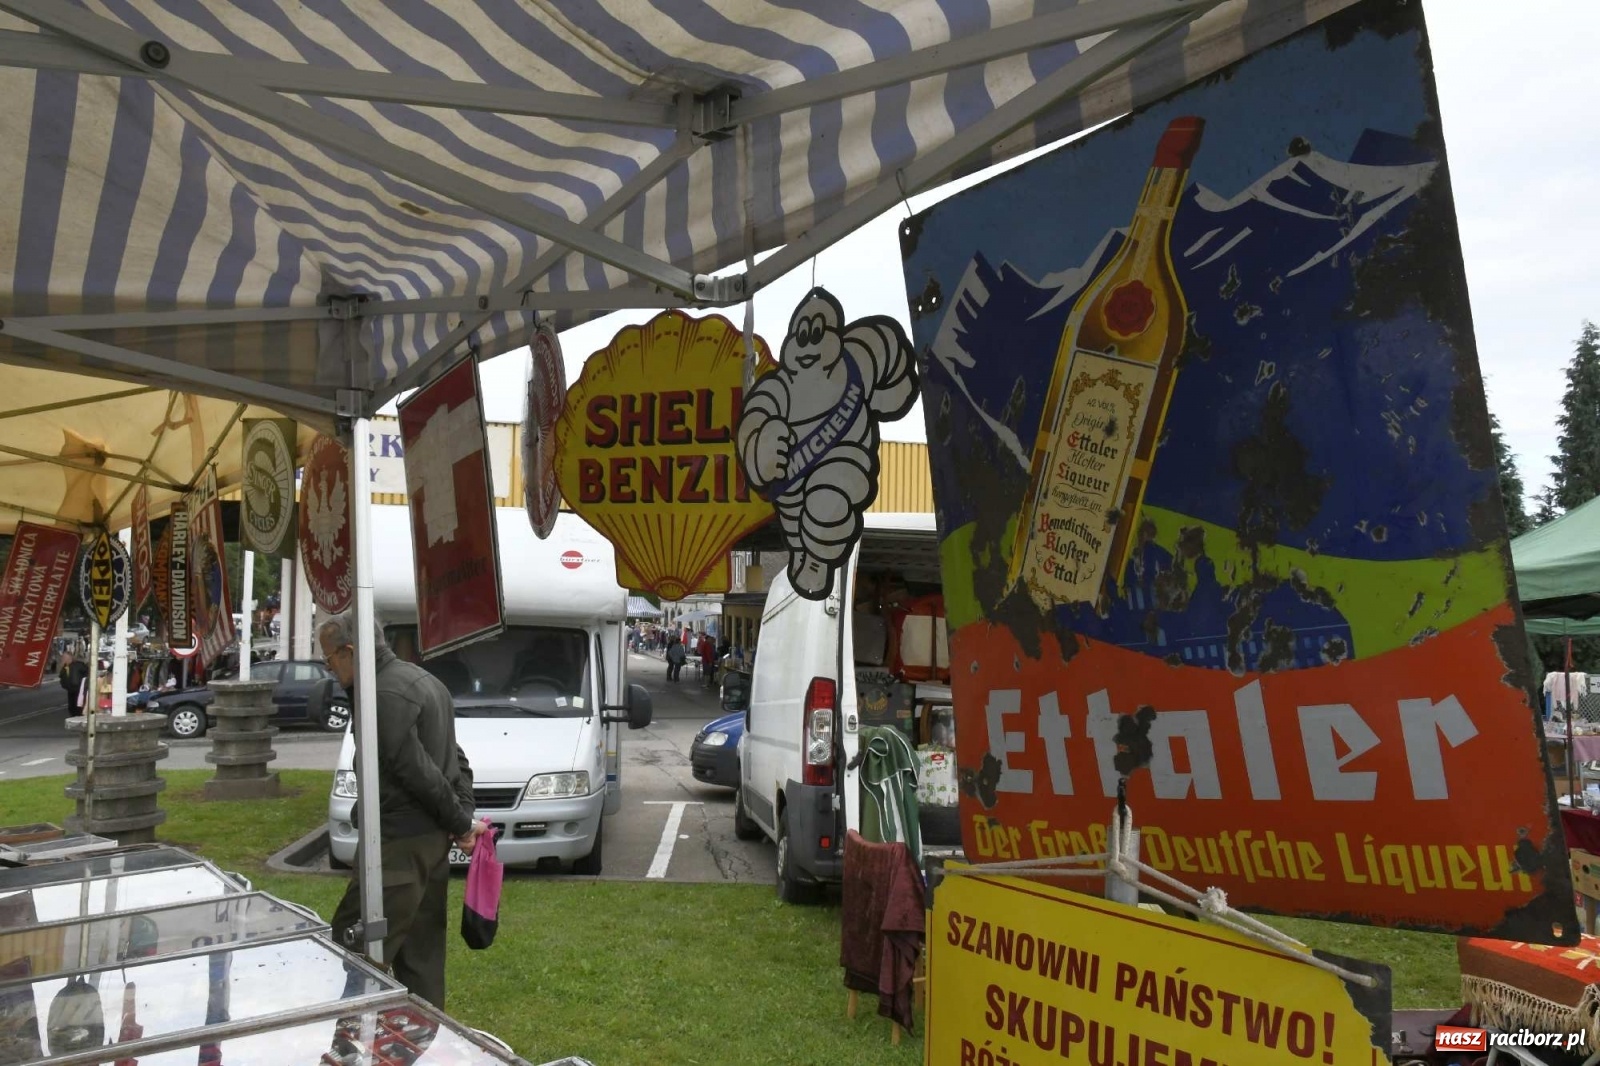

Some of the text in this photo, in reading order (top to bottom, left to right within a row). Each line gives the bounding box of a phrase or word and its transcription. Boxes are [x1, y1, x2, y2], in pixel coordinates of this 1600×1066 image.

[786, 382, 862, 482] MICHELIN
[1067, 430, 1118, 459] Ettaler
[247, 460, 276, 503] SINGER
[1056, 461, 1110, 493] Liqueur
[1037, 512, 1101, 554] Benedictiner
[171, 511, 188, 640] HARLEY-DAVIDSON
[1043, 555, 1079, 585] Ettal
[12, 565, 48, 645] TRANZYTOWA
[24, 550, 71, 667] NA WESTERPLATTE
[984, 679, 1480, 802] Ettaler
[972, 814, 1022, 859] Der
[946, 910, 1335, 1065] SZANOWNI PAŃSTWO!
